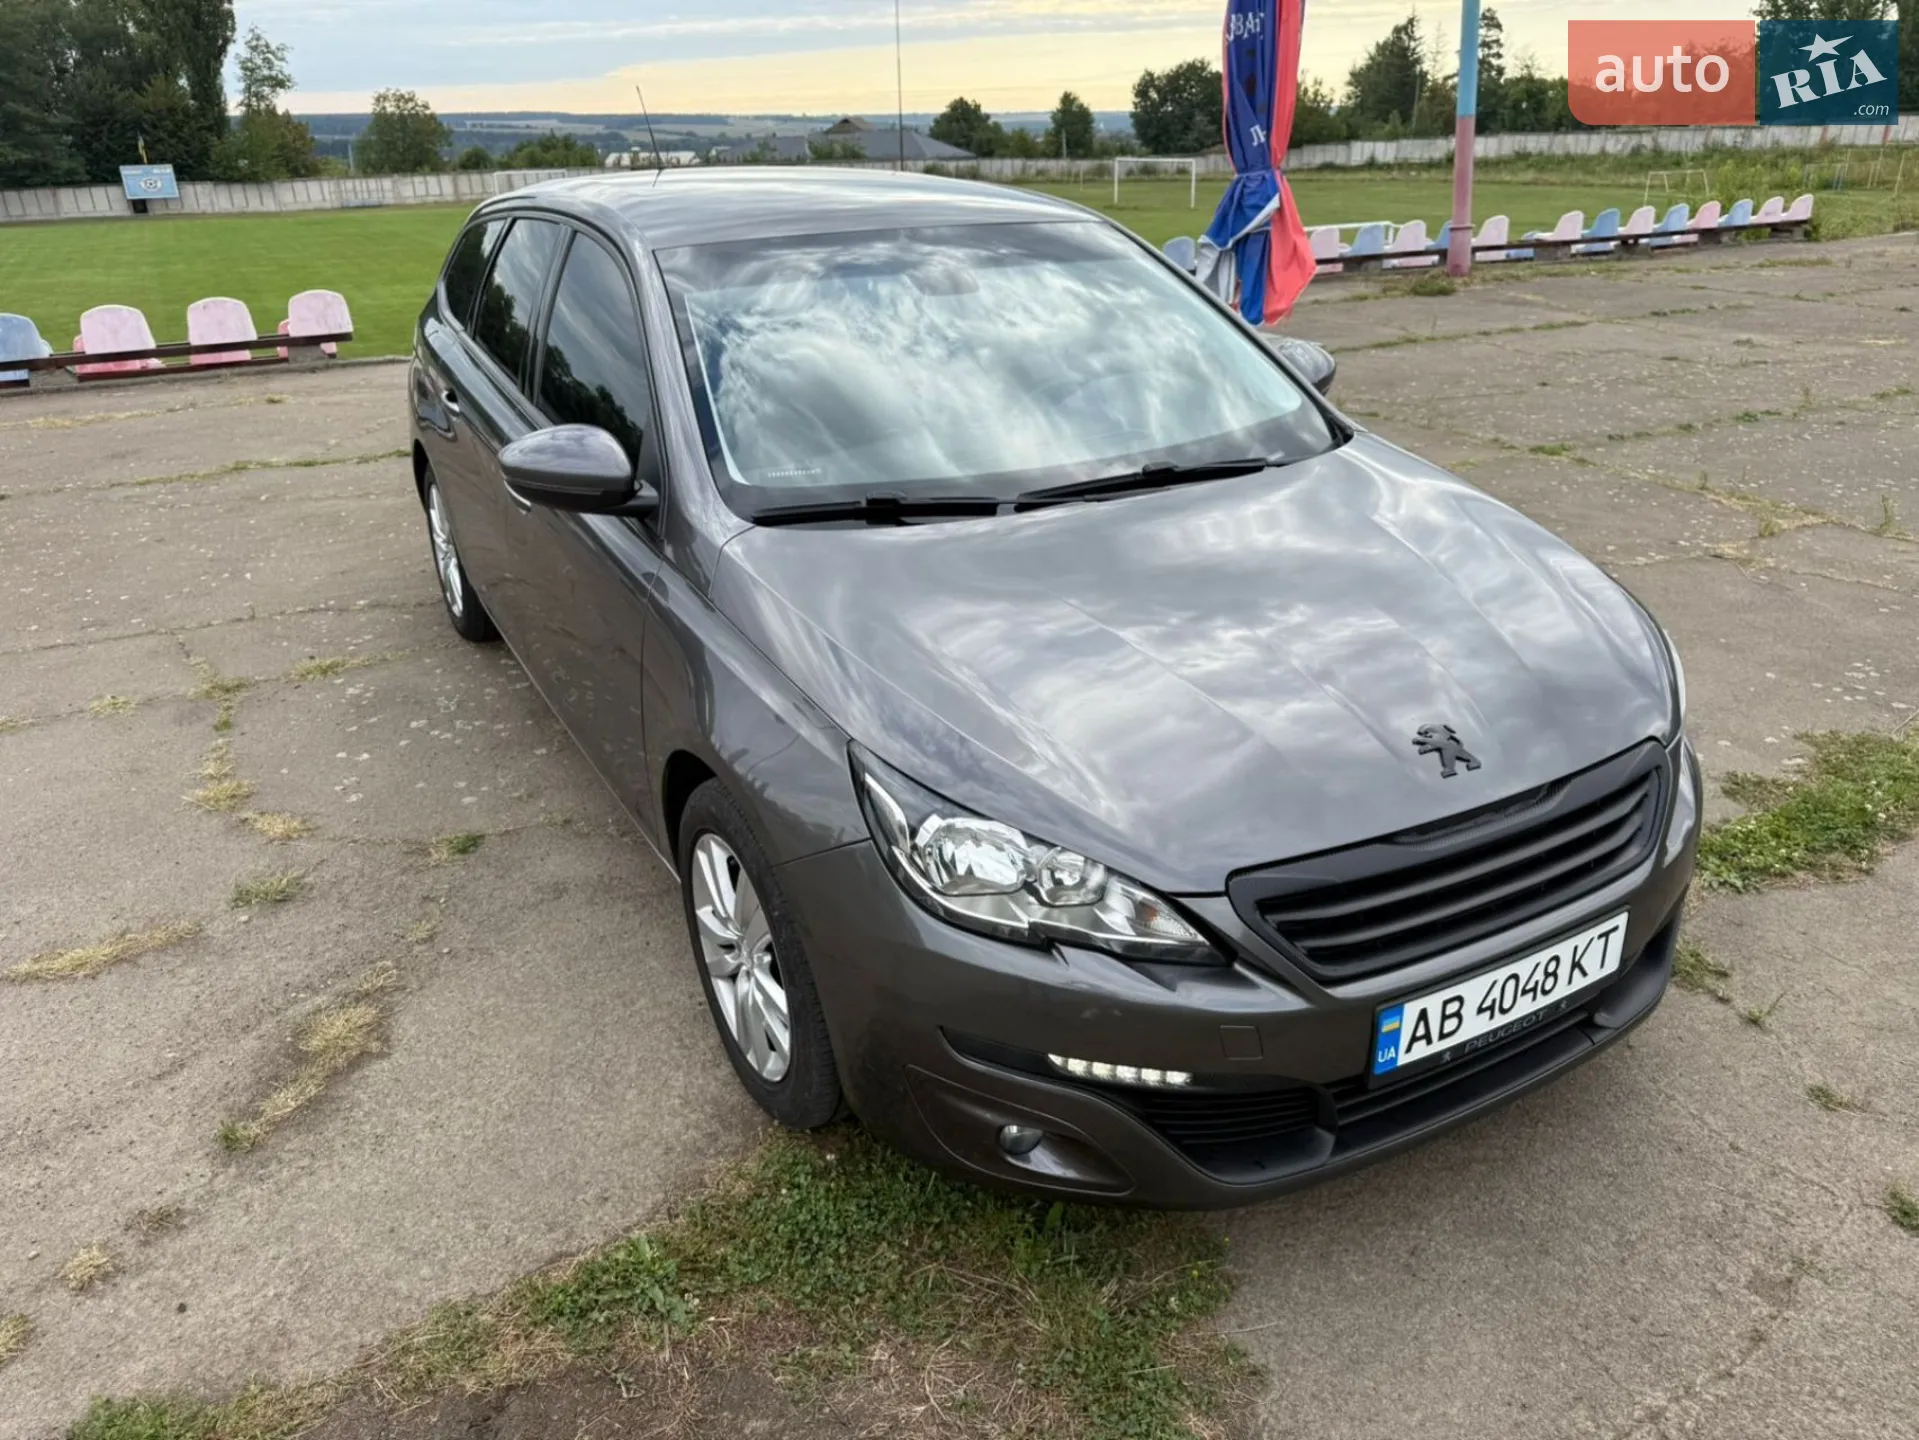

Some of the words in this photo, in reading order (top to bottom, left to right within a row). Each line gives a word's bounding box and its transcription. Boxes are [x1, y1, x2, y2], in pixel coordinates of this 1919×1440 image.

[1405, 994, 1464, 1054] AB
[1476, 954, 1561, 1021] 4048
[1568, 925, 1620, 986] KT
[1464, 1010, 1547, 1053] PEUGEOT
[1378, 1045, 1396, 1063] UA
